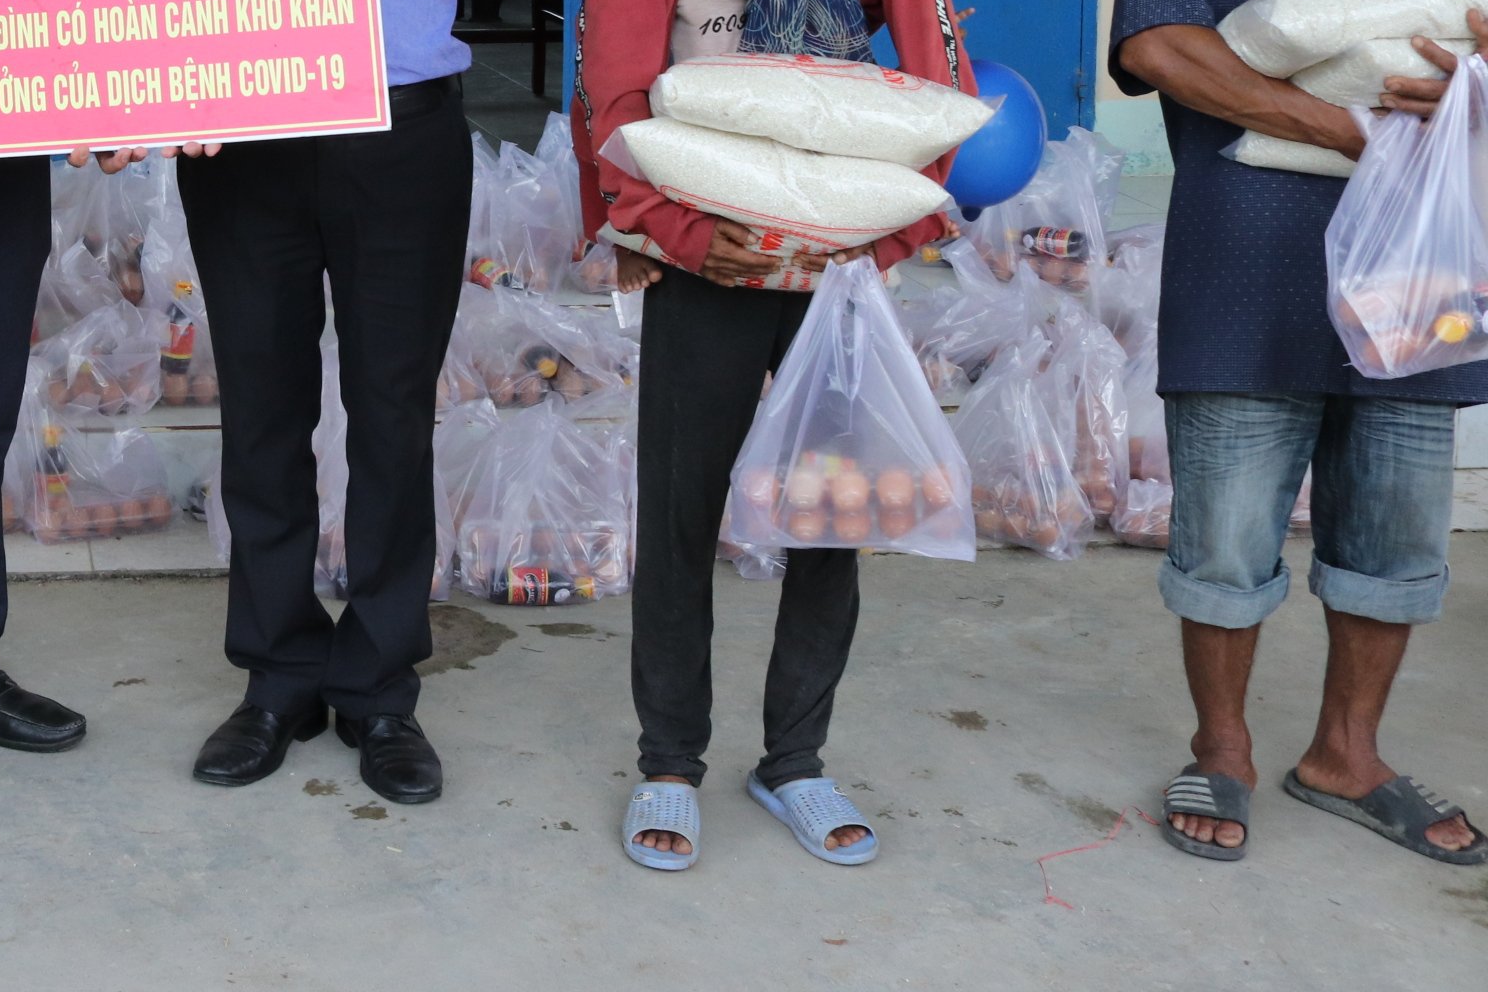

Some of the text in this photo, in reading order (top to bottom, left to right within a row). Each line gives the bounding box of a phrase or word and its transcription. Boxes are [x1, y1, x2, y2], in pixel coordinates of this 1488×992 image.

[56, 1, 88, 46] CÓ
[53, 60, 101, 111] CỦA
[107, 69, 163, 115] DỊCH
[168, 56, 232, 110] BỆNH
[238, 53, 346, 97] COVID-19
